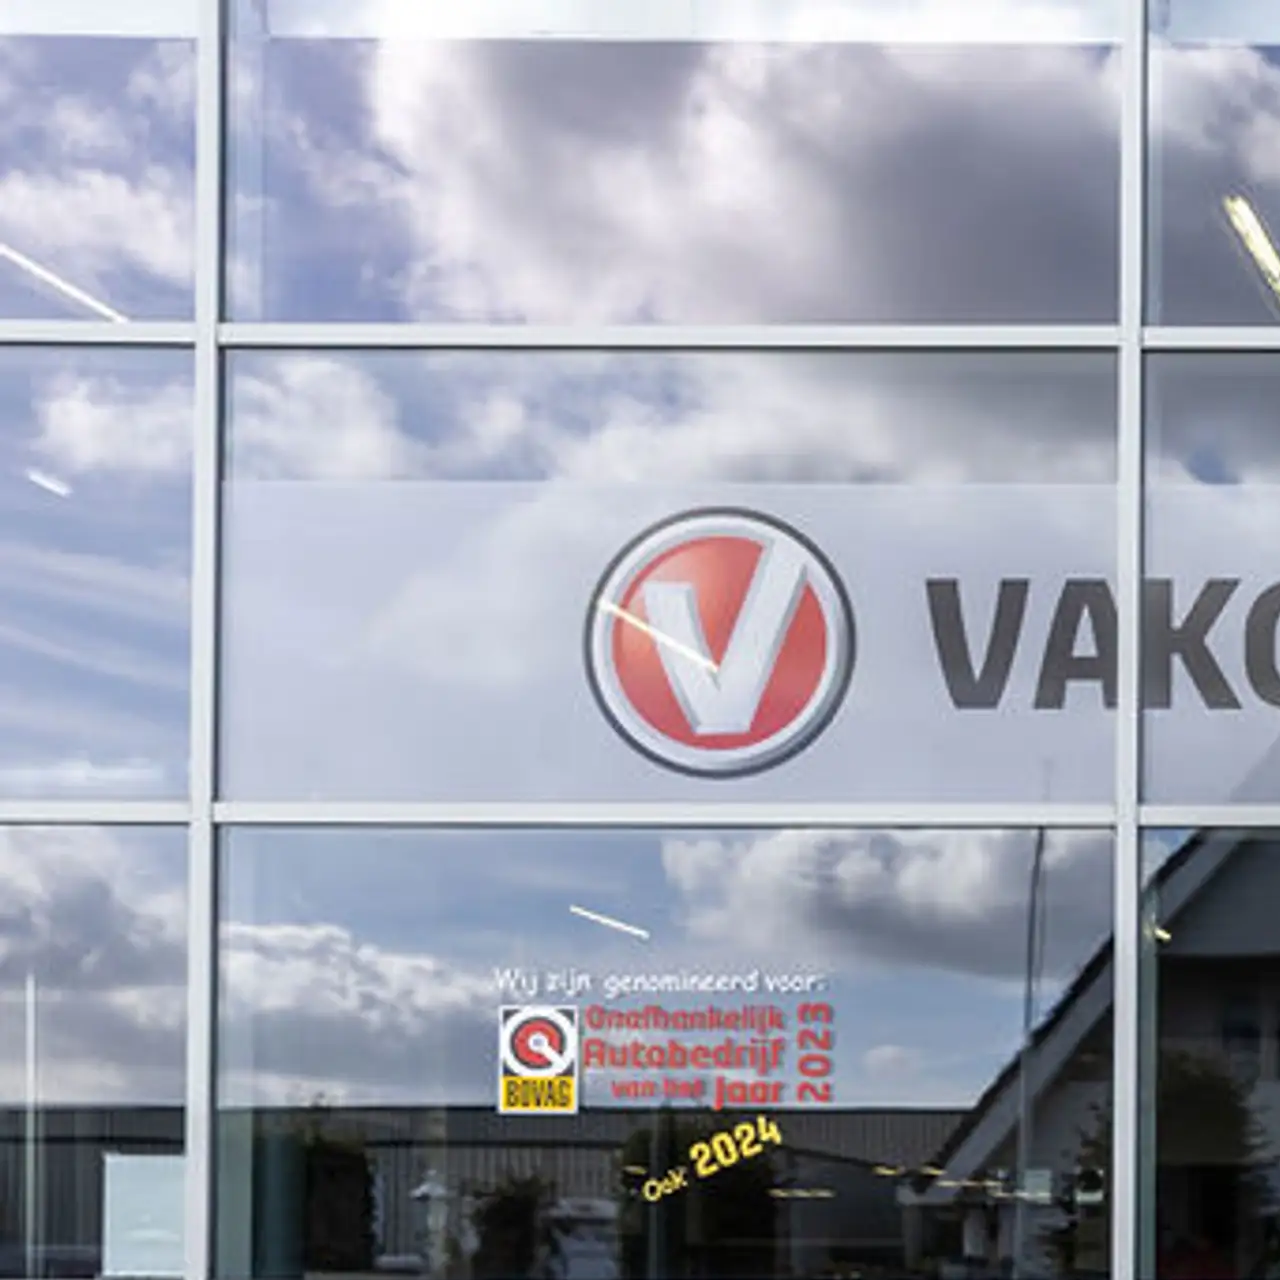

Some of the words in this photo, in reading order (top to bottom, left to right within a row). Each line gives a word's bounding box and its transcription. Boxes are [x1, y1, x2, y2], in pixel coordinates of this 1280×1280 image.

[546, 967, 592, 998] zijn
[603, 968, 760, 999] genomineerd
[584, 1004, 785, 1036] Onafhankelijk
[583, 1036, 786, 1077] Autobedrijf
[796, 1002, 834, 1104] 2023
[505, 1079, 572, 1108] BOVAG
[610, 1080, 656, 1099] van
[662, 1075, 704, 1098] het
[689, 1113, 782, 1178] 2024
